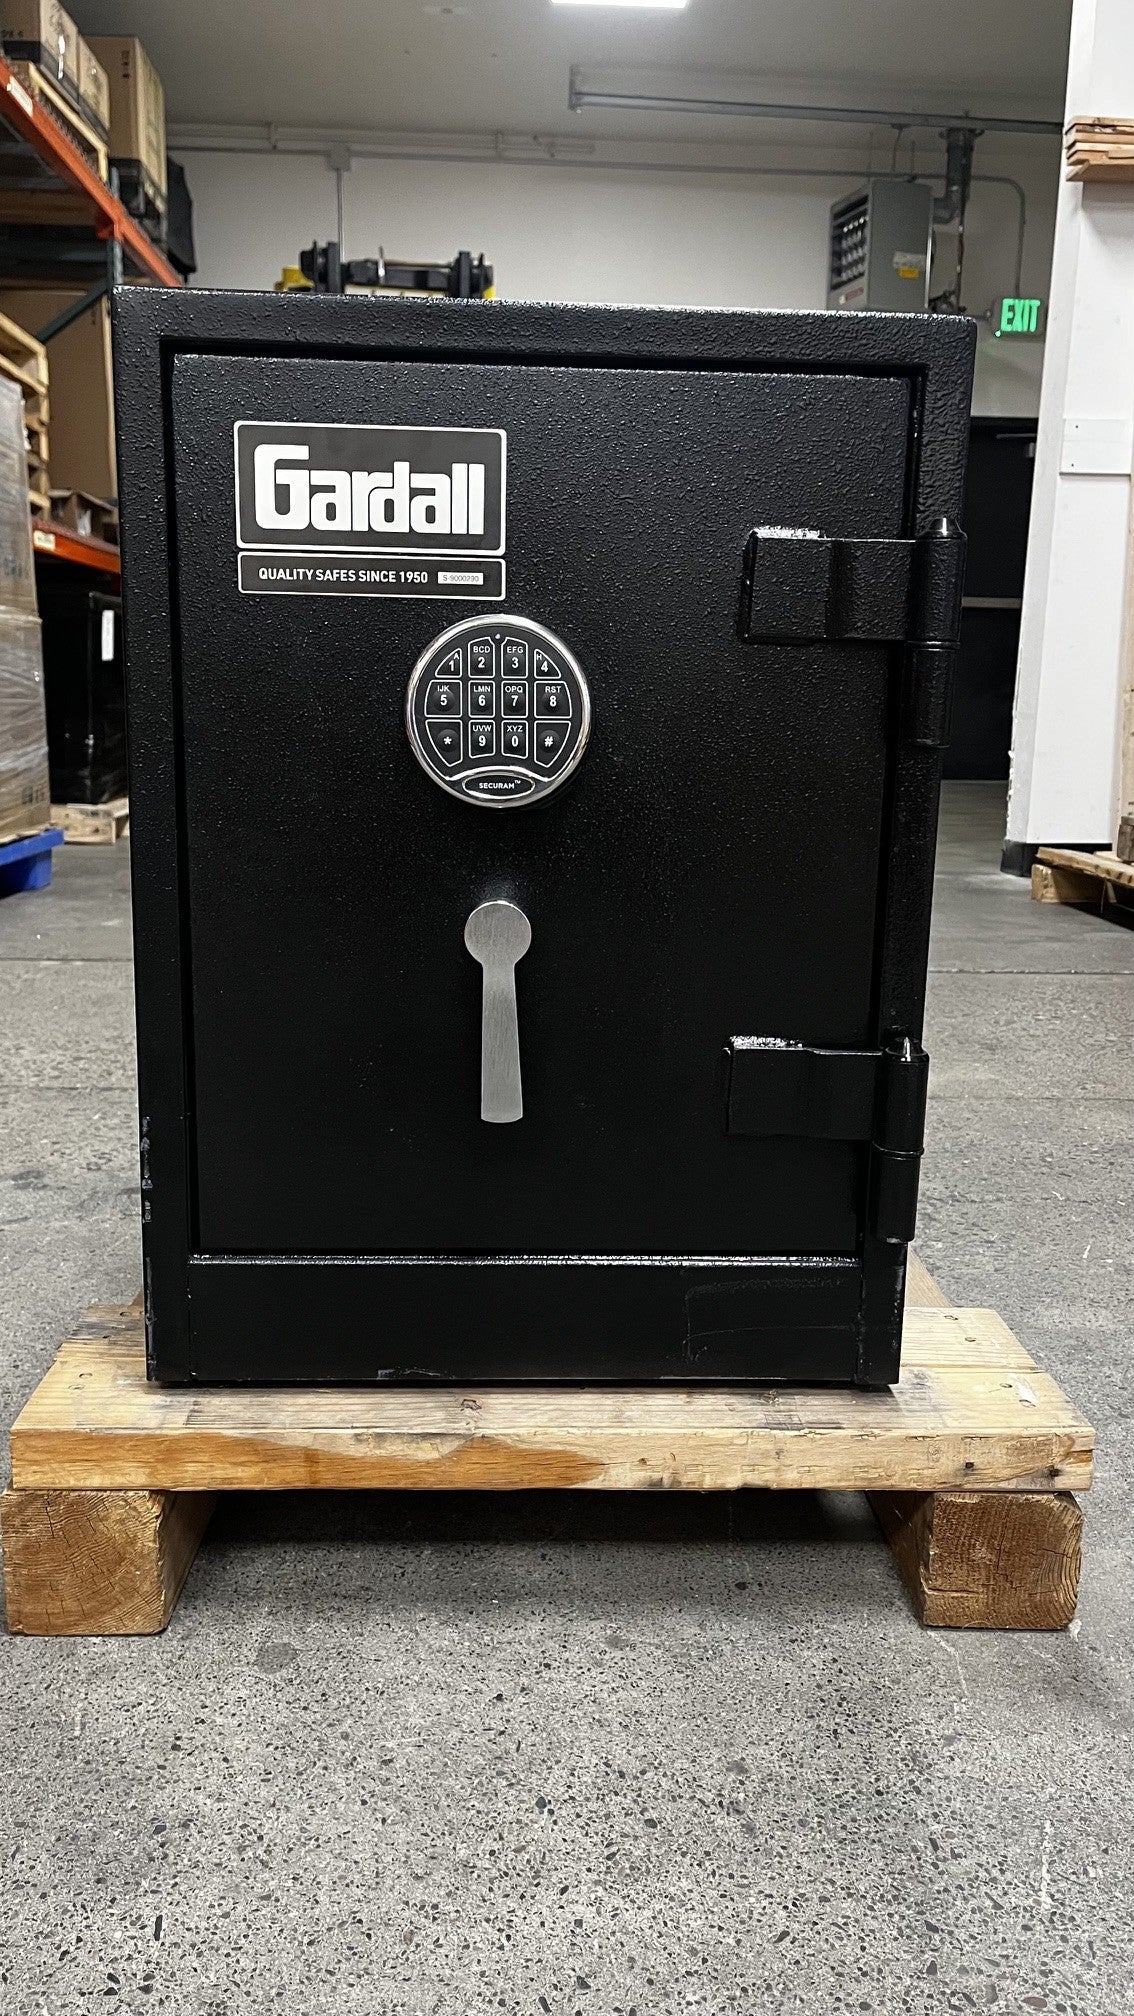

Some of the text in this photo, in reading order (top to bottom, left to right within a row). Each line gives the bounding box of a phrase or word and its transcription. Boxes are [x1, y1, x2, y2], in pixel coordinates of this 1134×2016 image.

[1000, 298, 1040, 332] EXIT
[254, 444, 484, 535] Gardall
[258, 567, 428, 583] QUALITY SAFES SINCE 1950
[473, 645, 490, 653] BCD
[506, 646, 524, 654] EFG
[453, 652, 460, 660] A
[536, 653, 543, 661] H
[448, 659, 455, 671] 1
[477, 656, 486, 668] 2
[511, 657, 519, 668] 3
[540, 661, 548, 672] 4
[505, 685, 523, 693] OPQ
[440, 694, 447, 706] 5
[478, 695, 486, 706] 6
[511, 695, 519, 706] 7
[549, 695, 557, 706] 8
[478, 735, 486, 747] 9
[511, 736, 519, 747] 0
